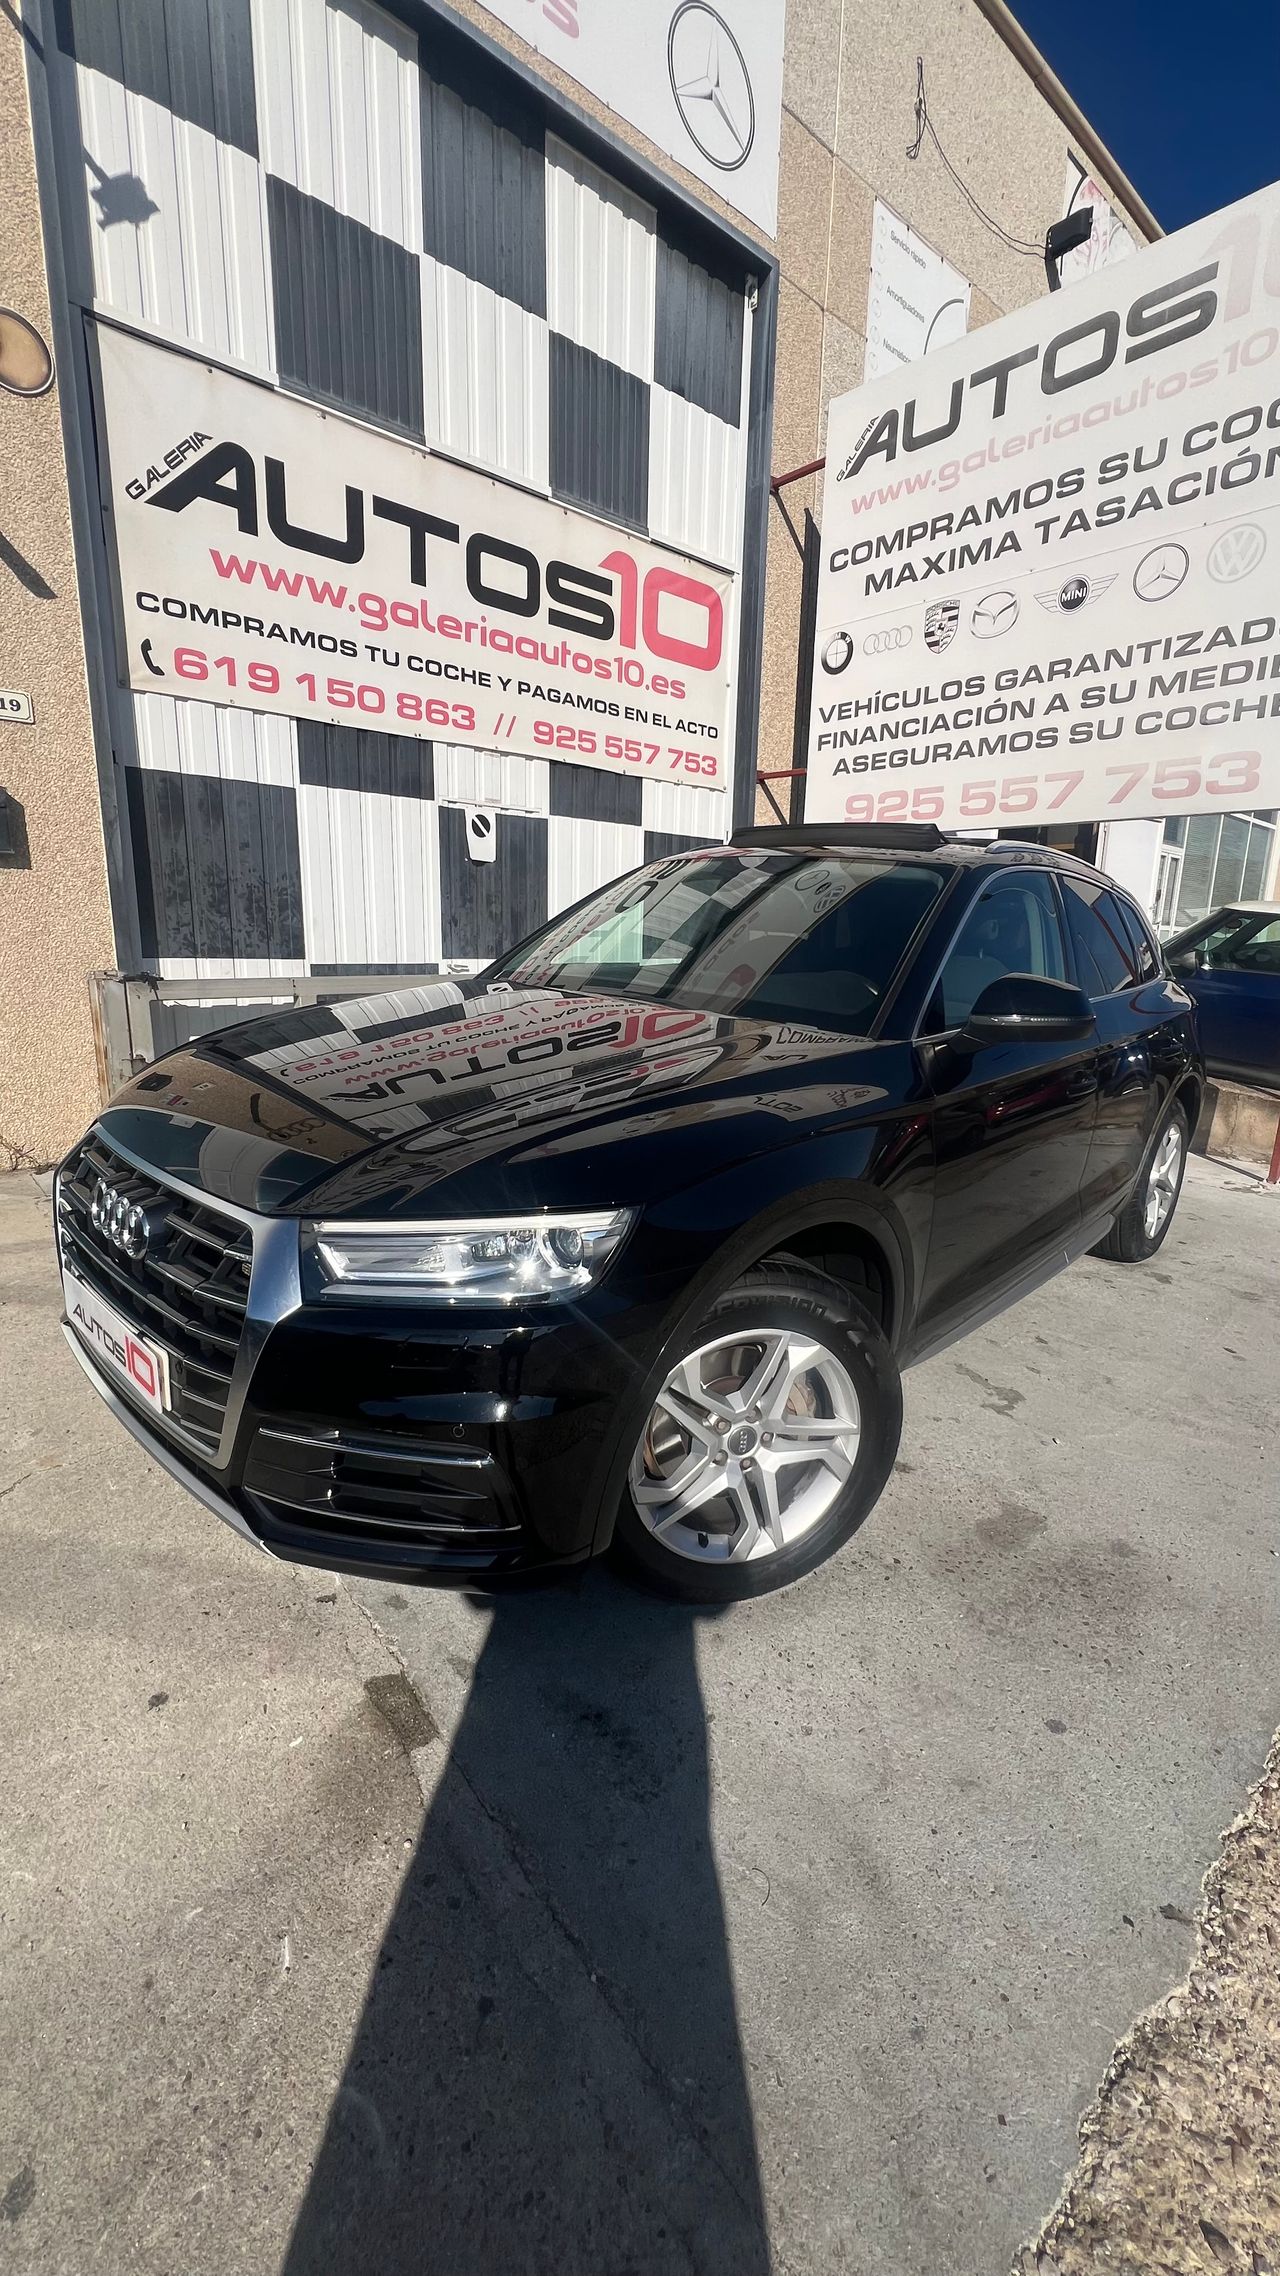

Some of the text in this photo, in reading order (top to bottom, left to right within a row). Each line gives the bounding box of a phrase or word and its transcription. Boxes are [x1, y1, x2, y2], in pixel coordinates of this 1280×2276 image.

[844, 208, 1280, 480] AUTOS1
[125, 431, 213, 500] GALERIA
[836, 415, 879, 482] GALERIA
[829, 468, 1085, 573] COMPRAMOS
[1098, 437, 1168, 485] SU
[144, 441, 724, 671] AUTOS10
[864, 529, 1022, 596] MAXIMA
[1061, 587, 1087, 604] MINI
[136, 591, 719, 739] COMPRAMOS TU COCHE Y PAGAMOS EN EL ACTO
[209, 548, 686, 699] www.galeriaautos10.es
[819, 616, 1280, 723] VEHÍCULOS GARANTIZAD
[174, 647, 280, 694] 619
[296, 673, 385, 714] 150
[396, 692, 475, 731] 863
[534, 721, 597, 753] 925
[605, 736, 661, 764] 557
[667, 748, 717, 776] 753
[817, 698, 1035, 751] FINANCIACIÓN
[1043, 693, 1070, 715] A
[1080, 680, 1137, 709] SU
[833, 727, 1059, 776] ASEGURAMOS
[1069, 716, 1124, 744] SU
[844, 751, 1262, 823] 925 557 753
[72, 1303, 156, 1396] AUTOS10
